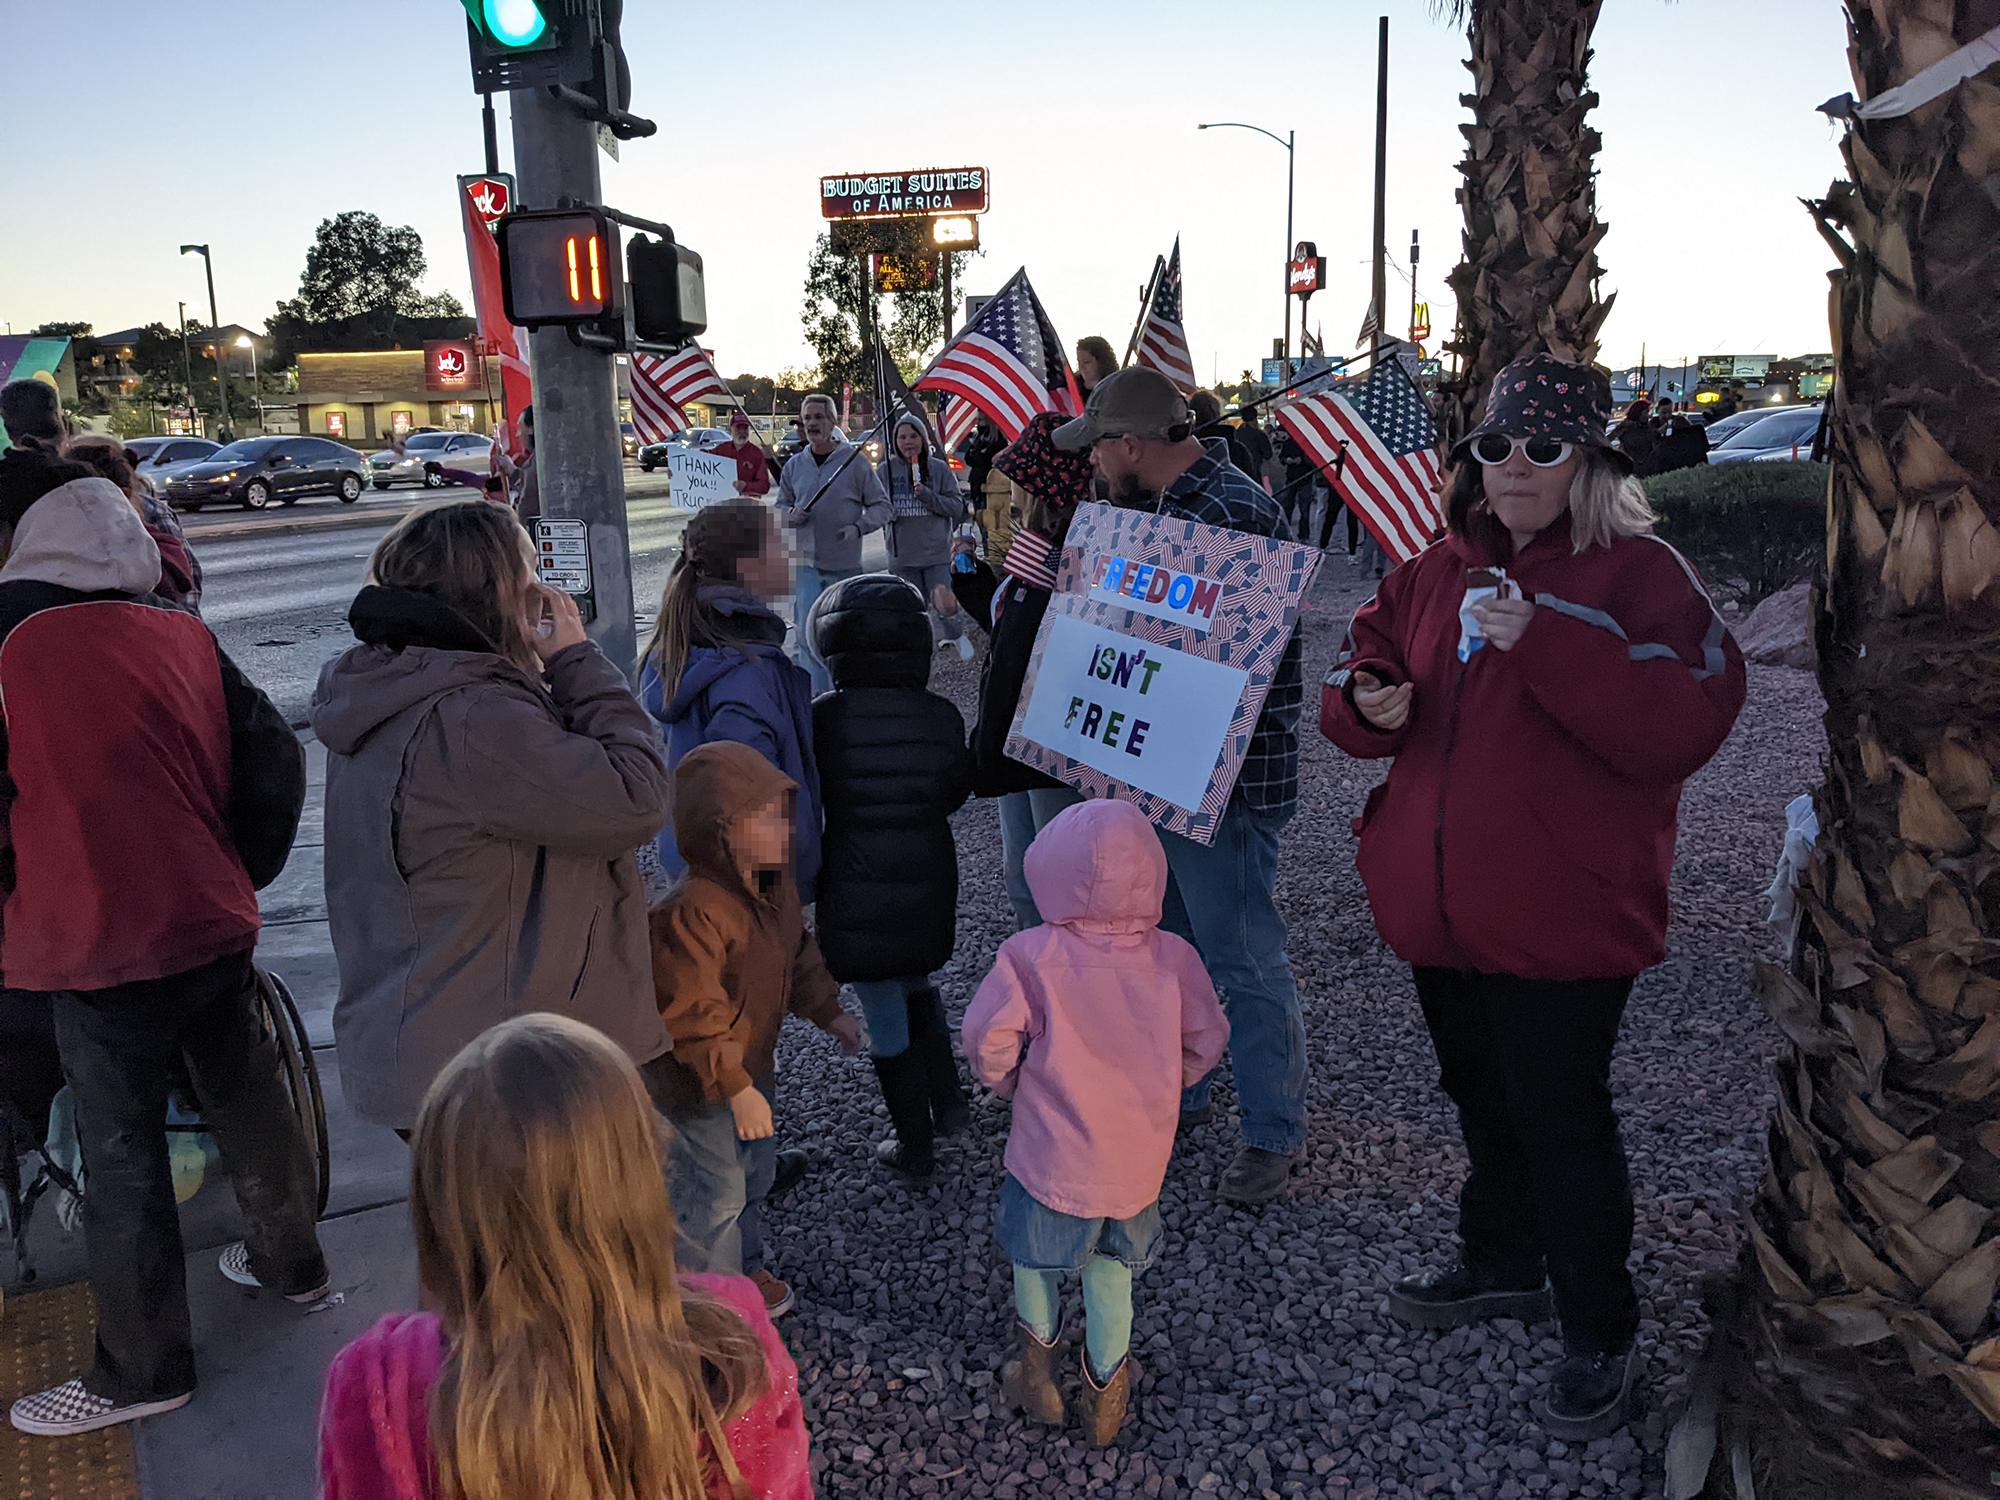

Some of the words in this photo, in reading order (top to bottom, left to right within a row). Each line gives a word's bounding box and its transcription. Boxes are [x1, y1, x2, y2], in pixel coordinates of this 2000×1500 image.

[823, 177, 903, 198] BUDGET
[908, 170, 983, 193] SUITES
[853, 199, 871, 213] OF
[877, 194, 953, 212] AMERICA
[567, 236, 601, 301] 11
[672, 454, 725, 479] THANK
[1093, 555, 1222, 619] FREEDOM
[1087, 643, 1162, 695] ISN'T
[1063, 696, 1151, 758] FREE
